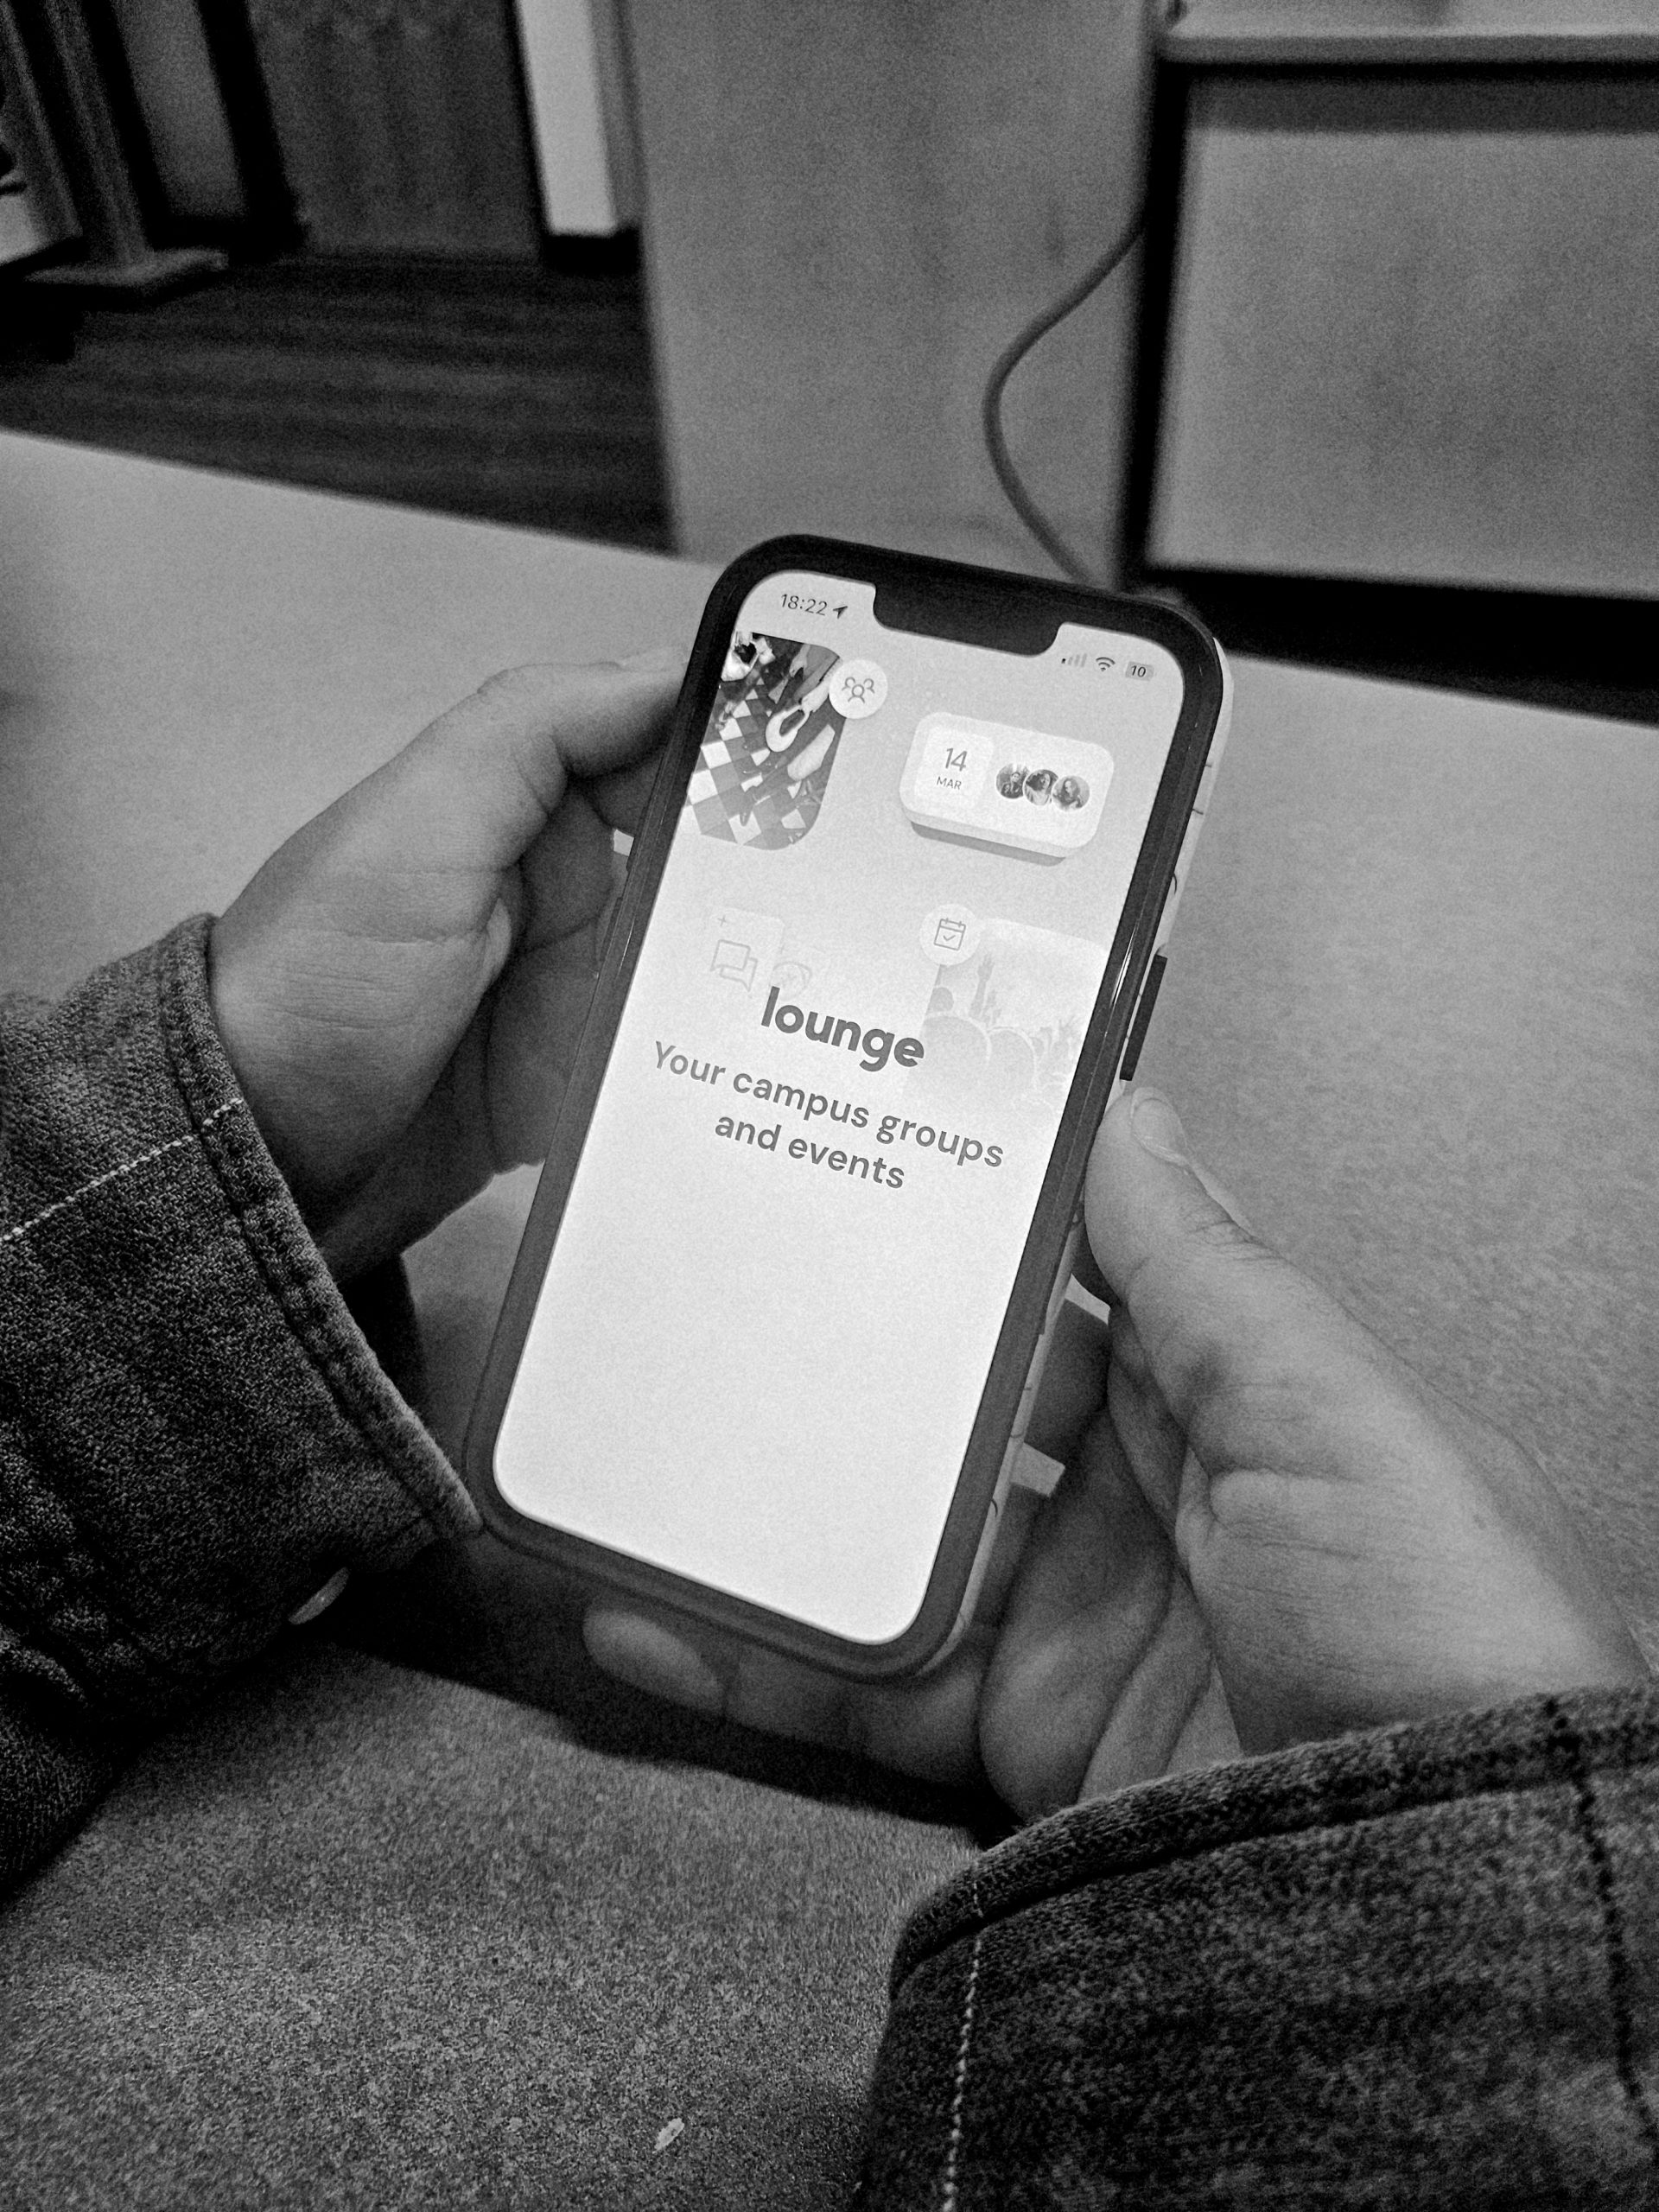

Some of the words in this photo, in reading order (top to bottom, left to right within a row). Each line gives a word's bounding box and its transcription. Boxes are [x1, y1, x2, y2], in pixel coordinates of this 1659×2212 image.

[779, 592, 829, 617] 18:22
[1130, 664, 1147, 679] 10
[944, 747, 968, 773] 14
[936, 775, 962, 791] MAR
[760, 986, 925, 1071] lounge
[654, 1040, 726, 1086] Your
[733, 1072, 869, 1128] campus
[875, 1115, 1004, 1168] groups
[715, 1115, 782, 1152] and
[787, 1136, 905, 1189] events
